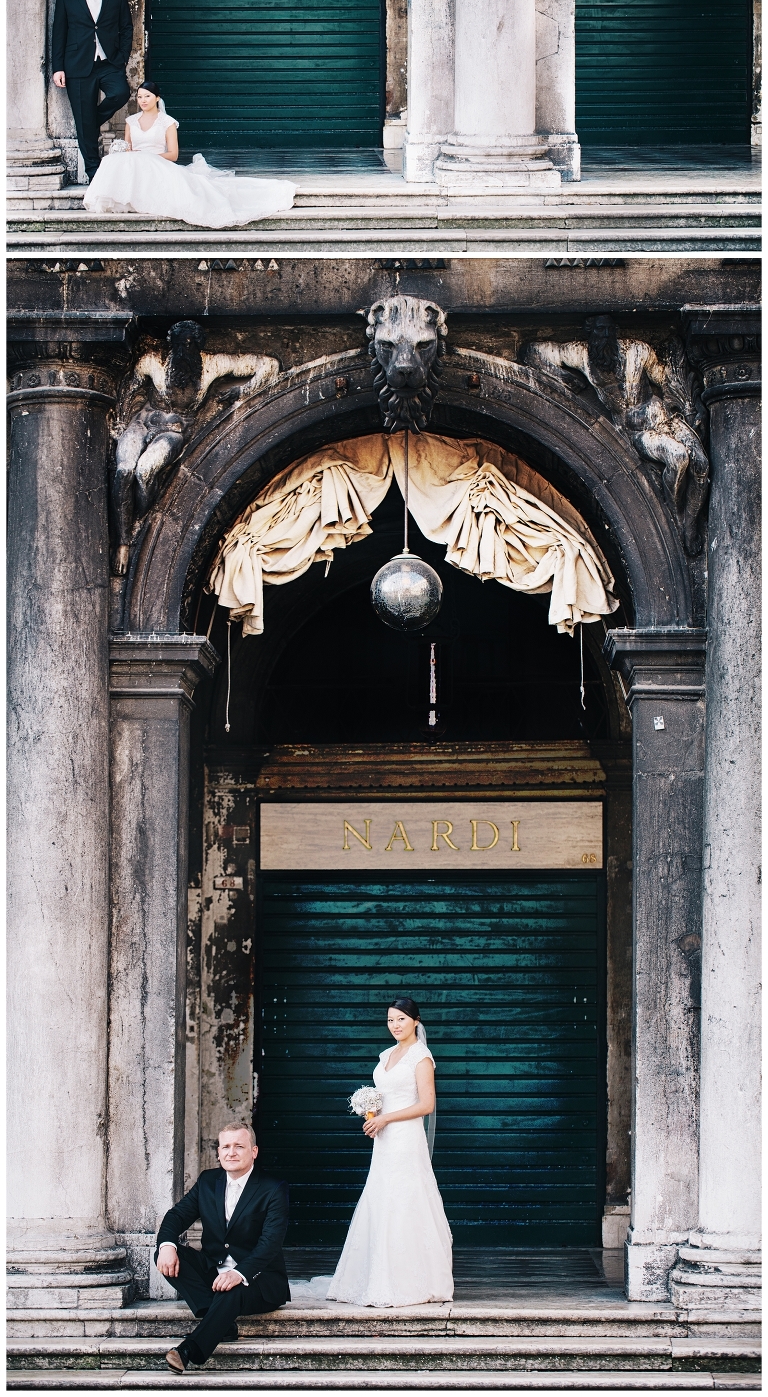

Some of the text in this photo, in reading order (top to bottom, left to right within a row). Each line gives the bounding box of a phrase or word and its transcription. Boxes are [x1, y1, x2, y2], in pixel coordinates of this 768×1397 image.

[342, 819, 521, 852] NARDI
[582, 853, 597, 863] 68
[221, 879, 236, 888] 68
